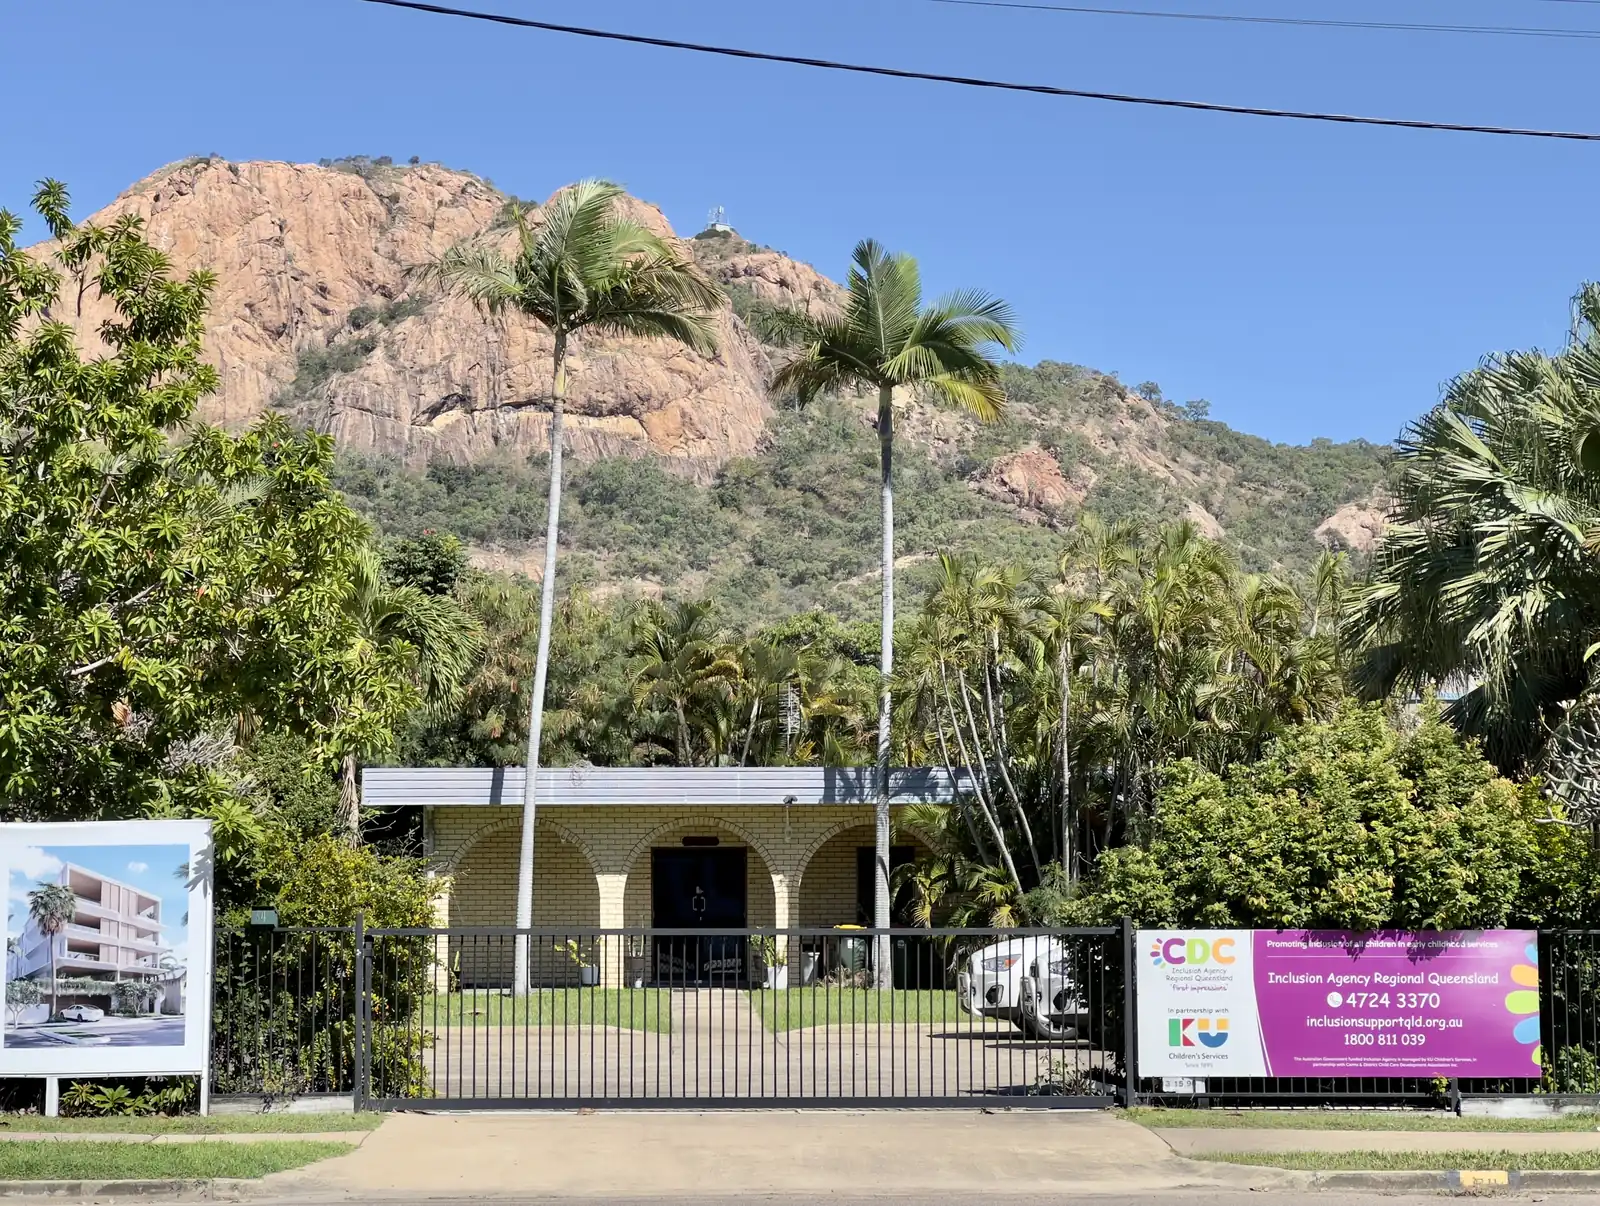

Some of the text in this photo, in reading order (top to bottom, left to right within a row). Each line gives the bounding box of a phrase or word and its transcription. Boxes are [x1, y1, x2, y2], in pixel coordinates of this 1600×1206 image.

[1162, 937, 1236, 965] CDC
[1266, 940, 1307, 949] Promoting
[1345, 939, 1352, 948] of
[1354, 939, 1363, 948] all
[1366, 939, 1396, 948] children
[1407, 940, 1426, 949] early
[1467, 940, 1499, 948] services
[1204, 967, 1227, 975] Agency
[1268, 972, 1499, 987] Inclusion Agency Regional Queensland
[1346, 992, 1441, 1008] 4724 3370
[1306, 1015, 1463, 1030] inclusionsupportqld.org.au
[1168, 1018, 1229, 1048] KU
[1344, 1033, 1426, 1046] 1800 811 039
[1168, 1052, 1201, 1060] Children's
